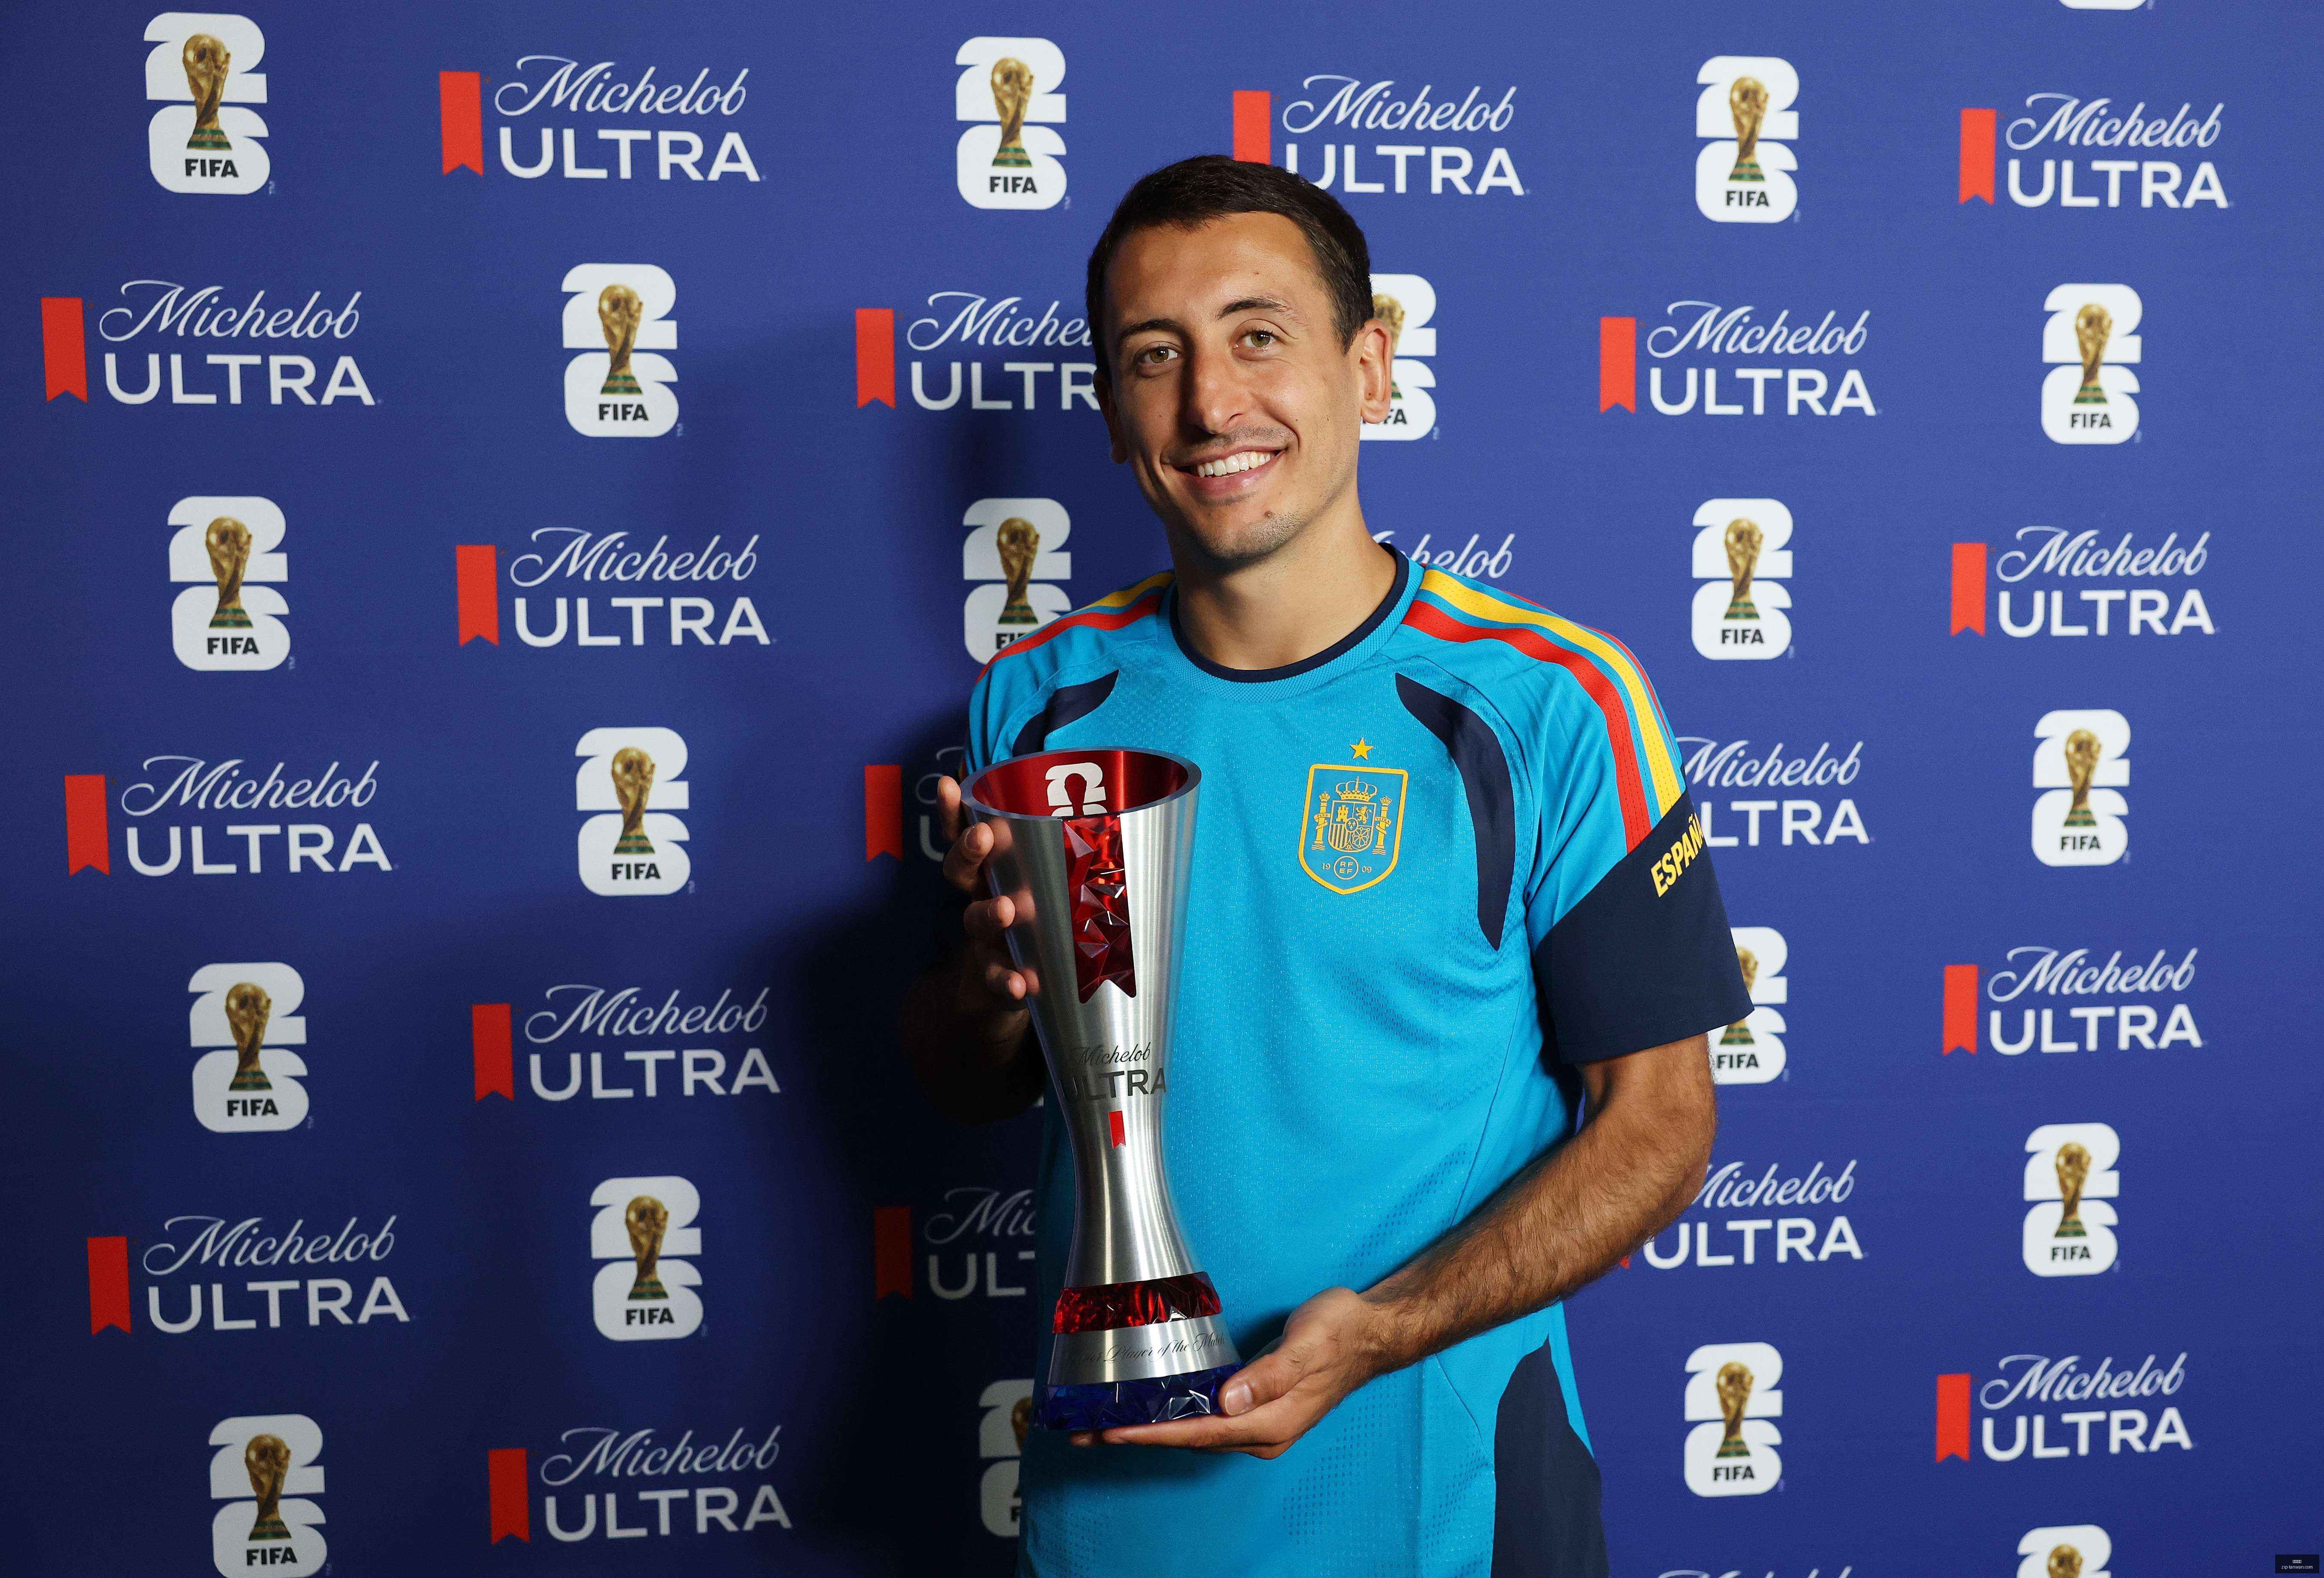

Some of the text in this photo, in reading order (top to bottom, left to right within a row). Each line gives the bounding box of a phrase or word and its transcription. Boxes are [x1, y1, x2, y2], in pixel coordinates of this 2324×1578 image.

[494, 55, 749, 116] Michelob
[1282, 74, 1517, 133] Michelob
[2006, 93, 2224, 150] Michelob
[184, 158, 239, 178] FIFA
[499, 127, 761, 182] ULTRA
[1286, 143, 1524, 196] ULTRA
[989, 176, 1037, 194] FIFA
[1726, 190, 1770, 207] FIFA
[2008, 159, 2229, 208] ULTRA
[99, 279, 362, 341] Michelob
[907, 291, 1093, 351] Miche
[1647, 300, 1870, 358] Michelob
[104, 353, 375, 406] ULTRA
[911, 361, 1101, 410] ULTR
[1650, 367, 1877, 416] ULTRA
[598, 403, 649, 421] FIFA
[2071, 413, 2111, 428] FIFA
[510, 527, 759, 587] Michelob
[1996, 526, 2210, 582] Michelob
[514, 597, 771, 647] ULTRA
[1721, 629, 1764, 644] FIFA
[1998, 589, 2215, 638] ULTRA
[207, 637, 259, 655] FIFA
[121, 755, 380, 816] Michelob
[1700, 799, 1870, 847] LTRA
[2060, 835, 2101, 851] FIFA
[126, 823, 392, 877] ULTRA
[611, 863, 661, 881] FIFA
[1988, 946, 2198, 1002] Michelob
[525, 985, 769, 1043] Michelob
[1989, 1004, 2202, 1056] ULTRA
[529, 1048, 780, 1101] ULTRA
[1717, 1053, 1759, 1070] FIFA
[226, 1098, 279, 1117] FIFA
[143, 1215, 397, 1275] Michelob
[1643, 1216, 1863, 1270] ULTRA
[2051, 1246, 2091, 1261] FIFA
[148, 1276, 410, 1334] ULTRA
[625, 1307, 675, 1326] FIFA
[1104, 1344, 1153, 1364] Player
[1156, 1340, 1178, 1360] of
[1172, 1339, 1190, 1353] the
[1980, 1353, 2187, 1409] Michelob
[541, 1425, 781, 1486] Michelob
[1982, 1407, 2193, 1462] ULTRA
[1713, 1465, 1755, 1482] FIFA
[545, 1485, 791, 1542] ULTRA
[246, 1546, 298, 1566] FIFA
